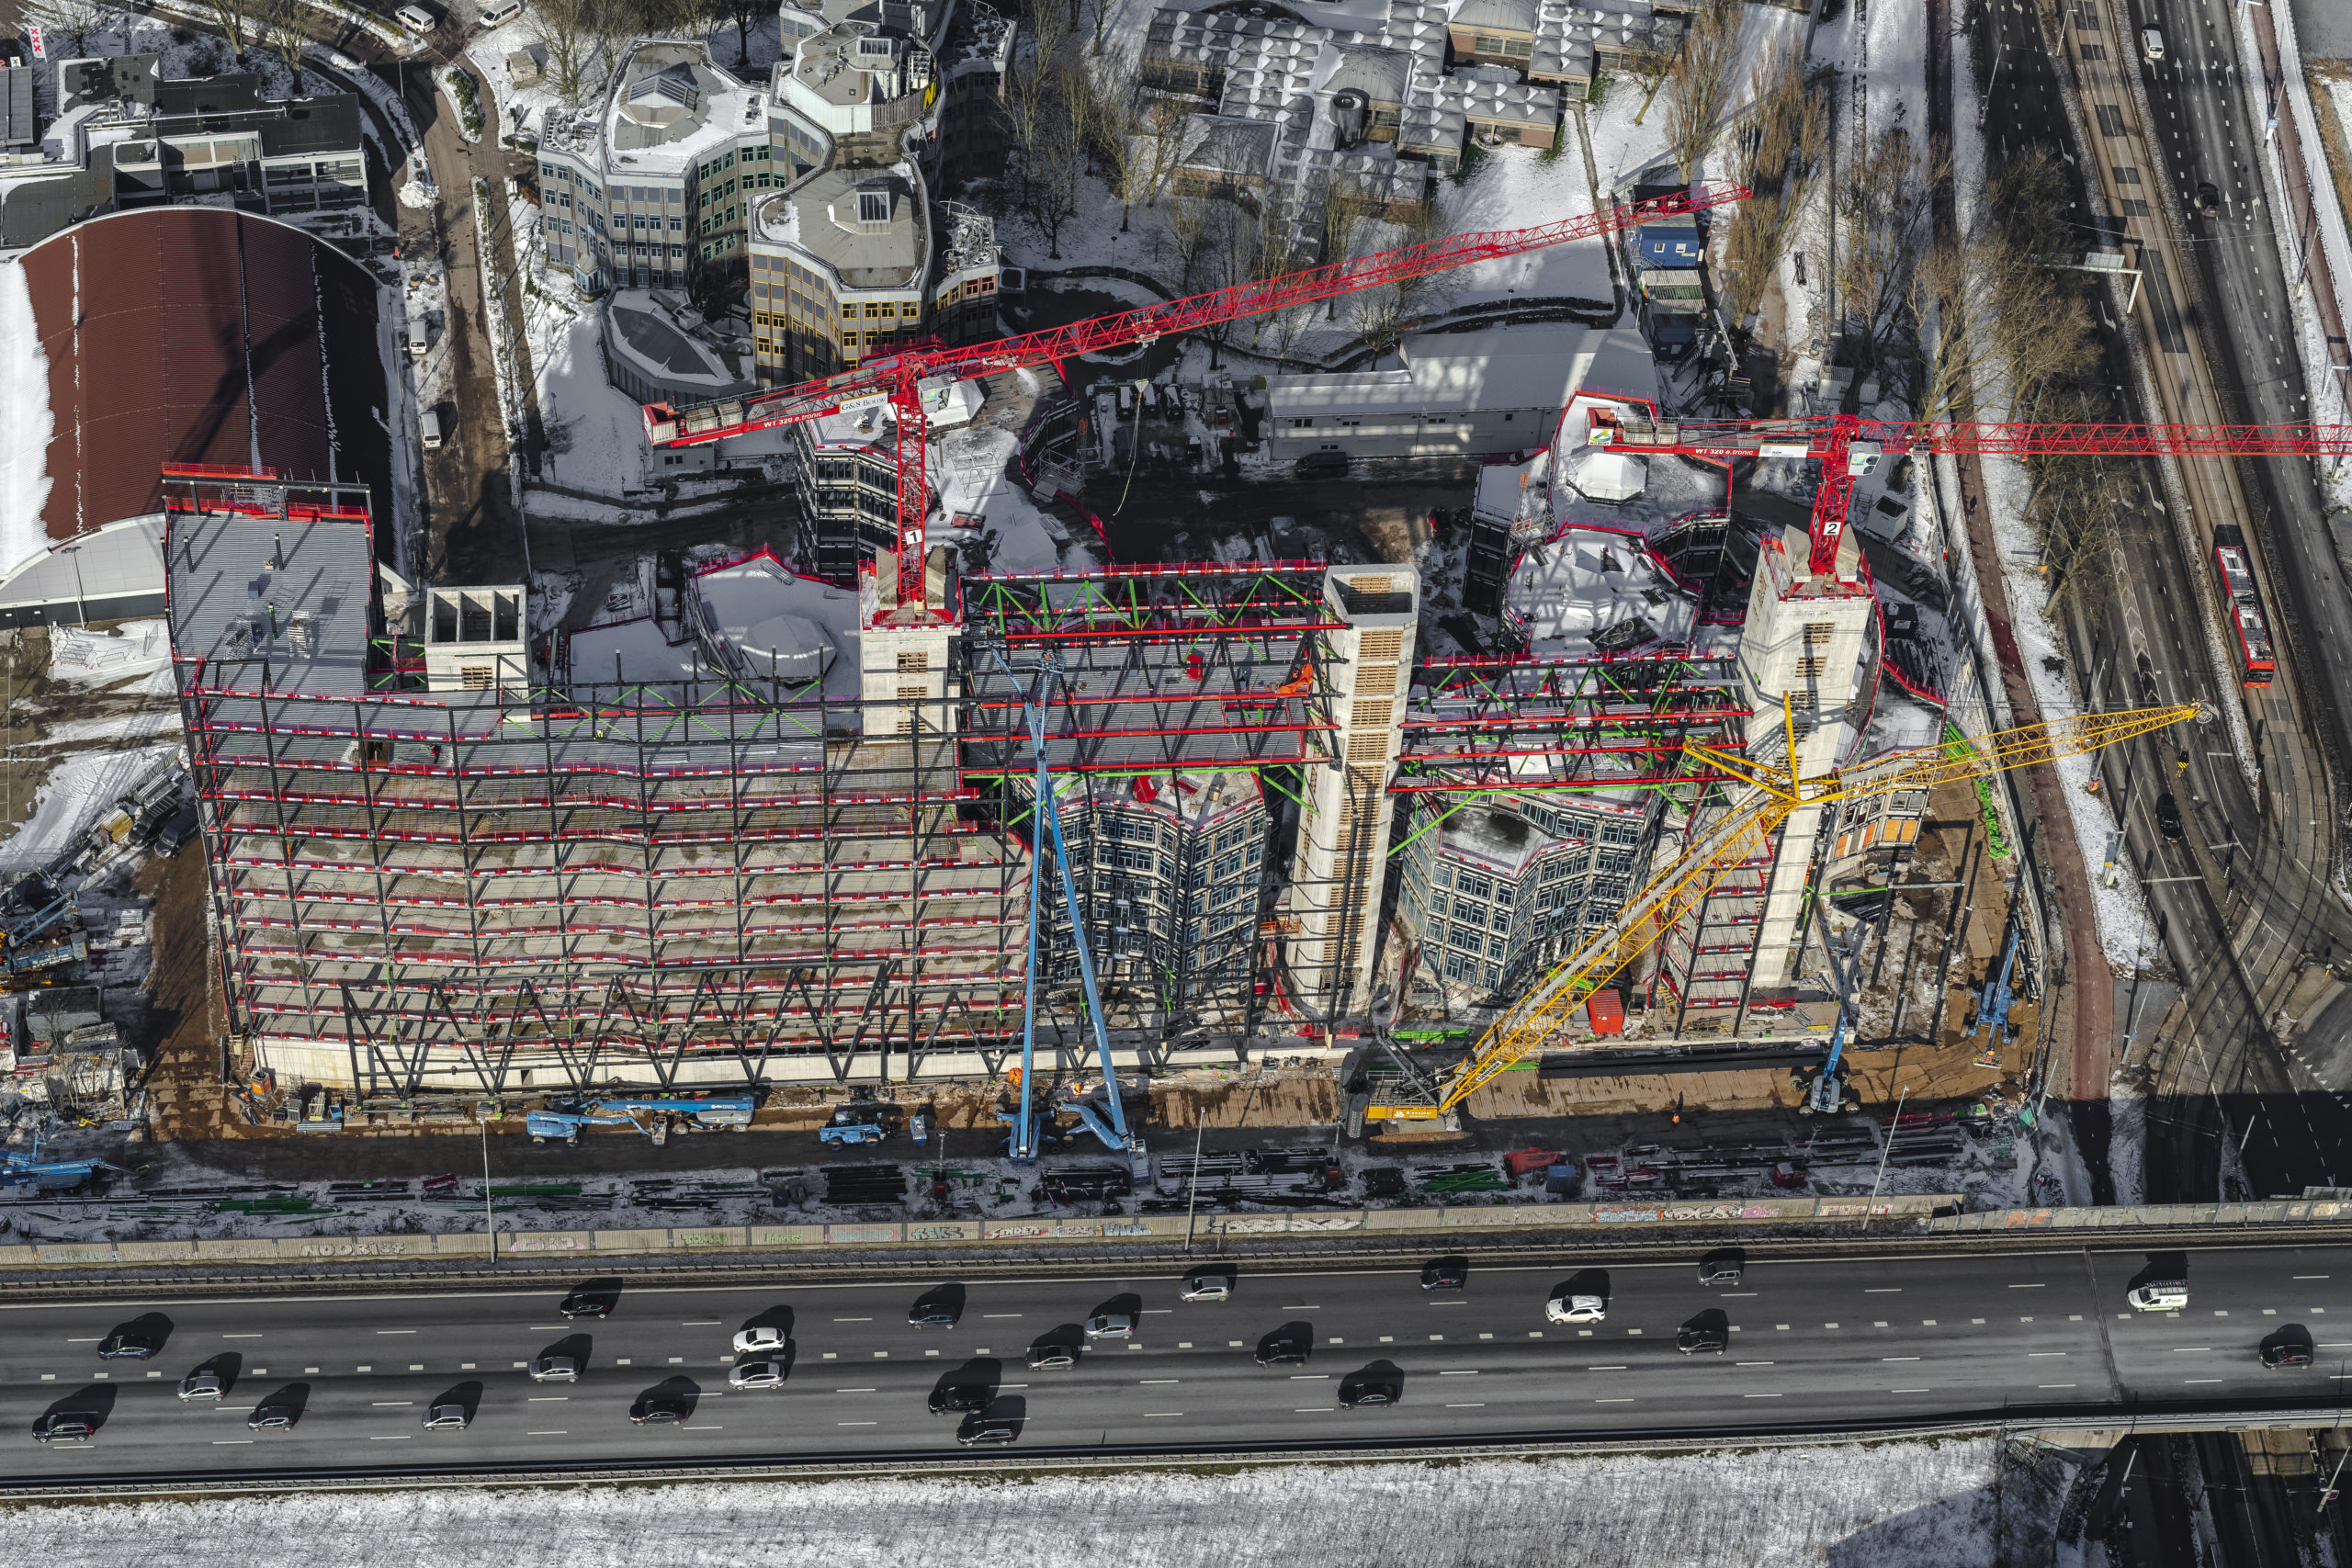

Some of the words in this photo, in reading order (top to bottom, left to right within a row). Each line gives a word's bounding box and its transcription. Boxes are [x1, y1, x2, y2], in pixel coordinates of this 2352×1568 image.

[841, 400, 862, 412] G&S
[779, 416, 794, 425] 320
[794, 411, 823, 423] e.tronic
[1826, 523, 1838, 535] 2
[909, 531, 918, 542] 1
